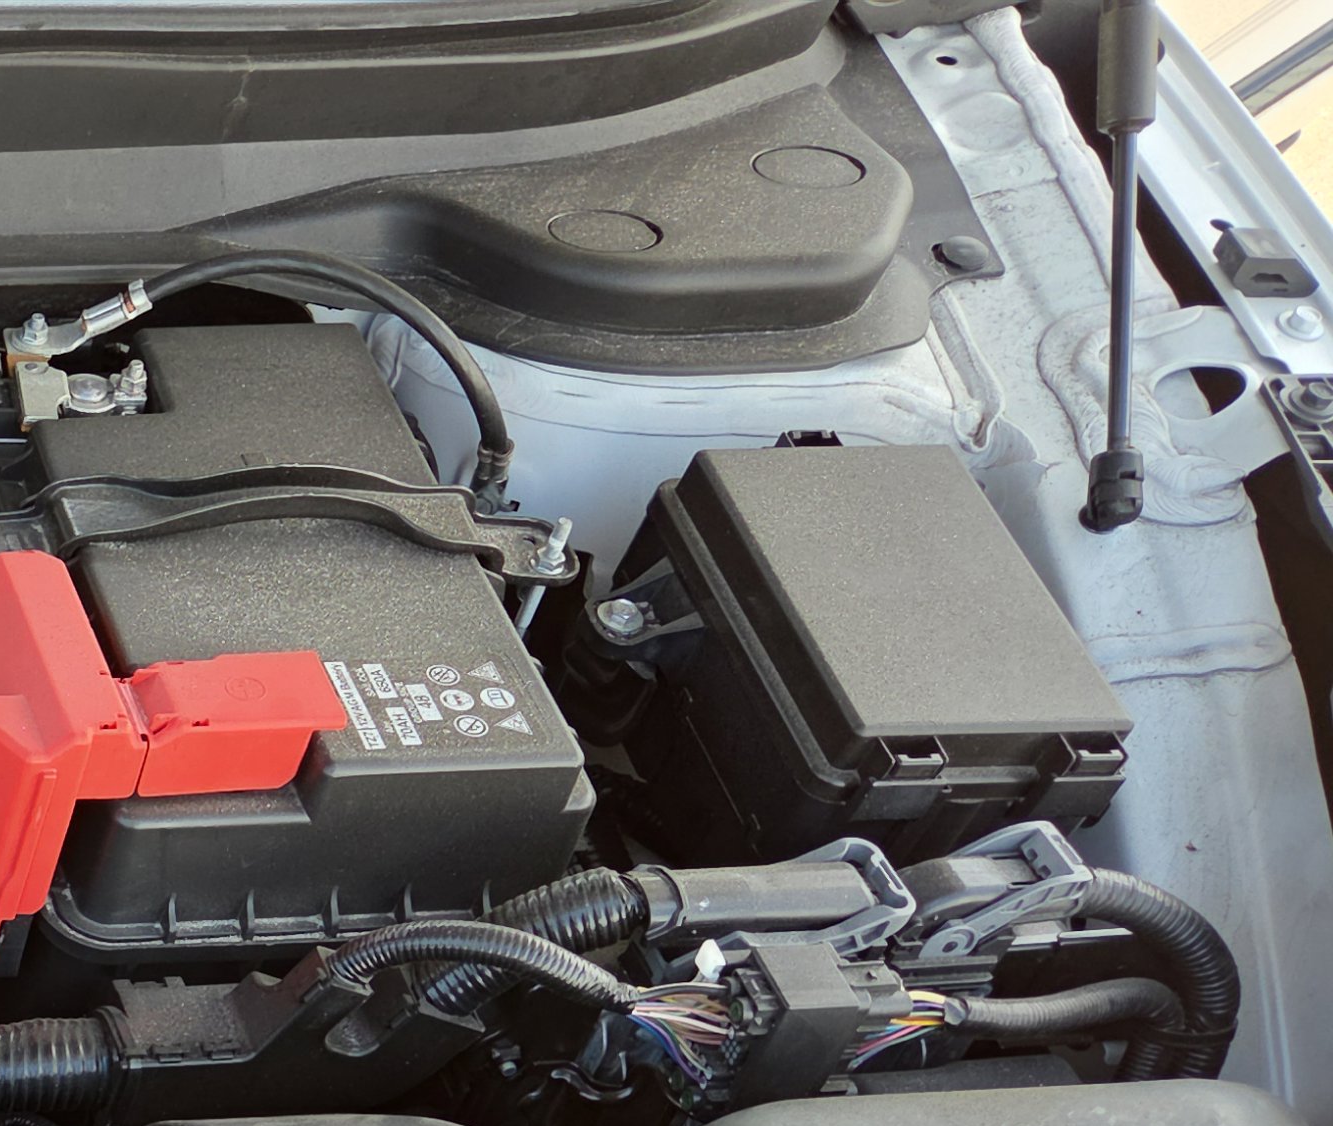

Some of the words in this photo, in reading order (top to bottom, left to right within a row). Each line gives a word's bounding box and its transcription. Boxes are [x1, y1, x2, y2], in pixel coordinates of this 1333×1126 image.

[343, 692, 363, 711] AGM
[413, 695, 432, 709] 48
[392, 713, 416, 740] 70AH
